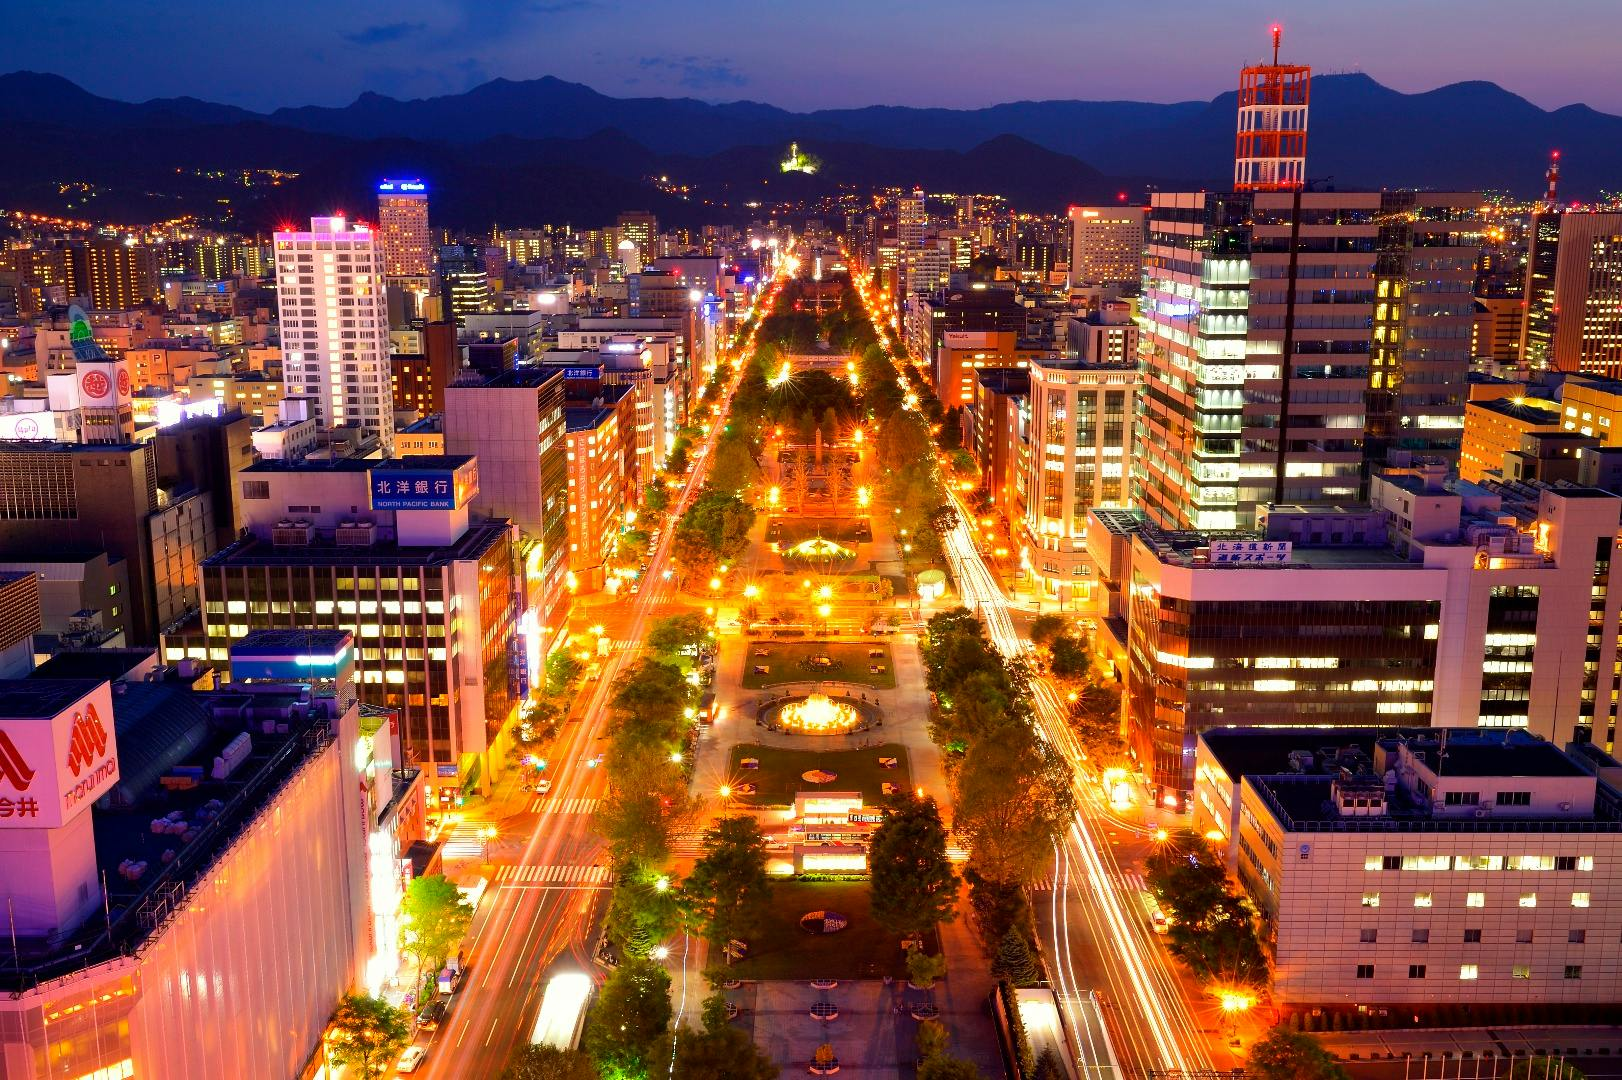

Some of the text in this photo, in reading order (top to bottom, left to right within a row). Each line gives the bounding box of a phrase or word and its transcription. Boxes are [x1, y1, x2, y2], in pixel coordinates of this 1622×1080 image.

[154, 354, 161, 362] P
[567, 369, 593, 377] 北洋銀行
[377, 480, 448, 495] 北洋銀行
[1216, 542, 1287, 551] 北海道新聞
[1216, 553, 1287, 561] 道新スポーツ
[519, 650, 527, 685] 北洋銀行
[0, 797, 39, 818] 今井
